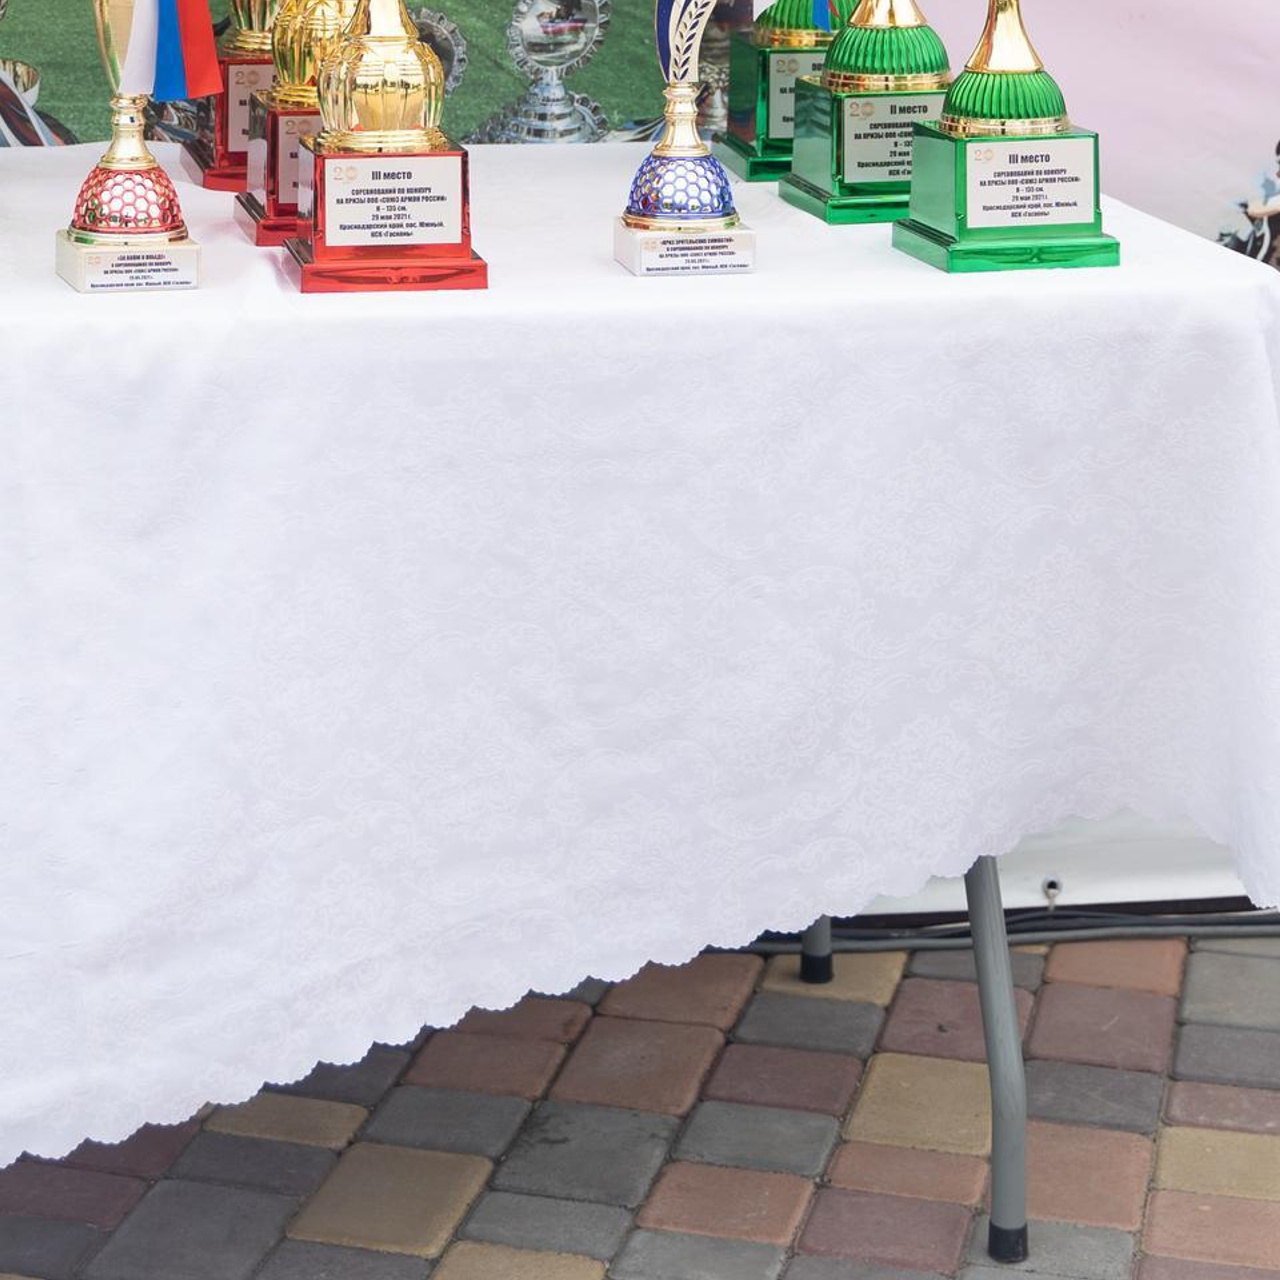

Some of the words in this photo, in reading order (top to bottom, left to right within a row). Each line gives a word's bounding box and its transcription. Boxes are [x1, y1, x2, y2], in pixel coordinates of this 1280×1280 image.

[890, 104, 897, 115] II
[898, 103, 929, 115] место
[1008, 154, 1019, 165] III
[1020, 153, 1051, 164] место
[371, 170, 382, 181] III
[383, 170, 413, 181] место
